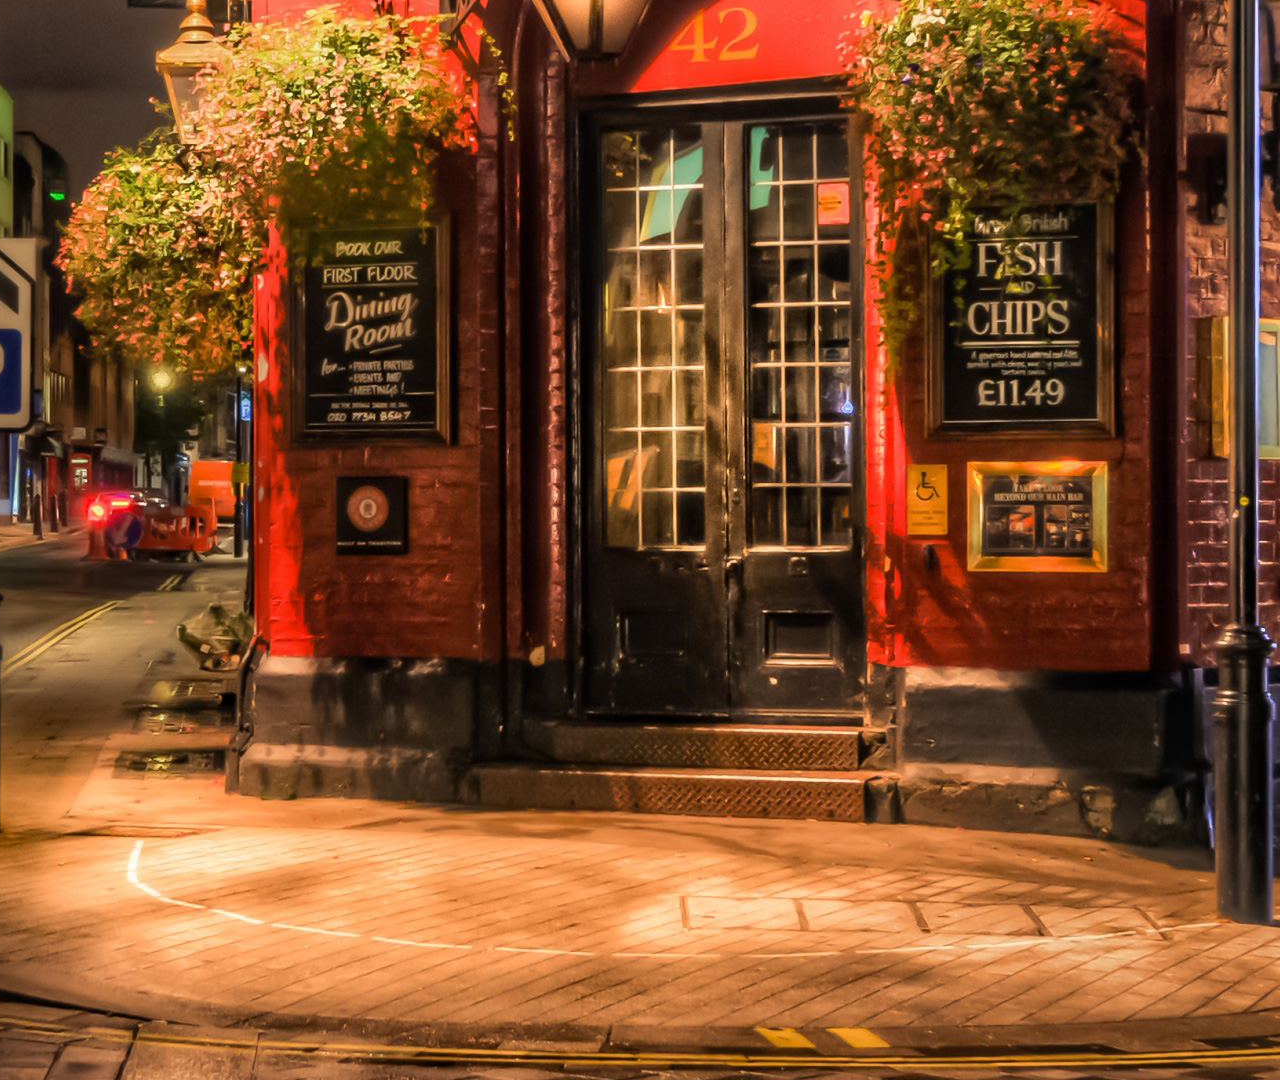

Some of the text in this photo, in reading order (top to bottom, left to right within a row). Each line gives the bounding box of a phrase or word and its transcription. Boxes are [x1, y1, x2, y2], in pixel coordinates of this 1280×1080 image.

[669, 6, 760, 63] 42
[336, 240, 404, 258] BOOK OUR
[977, 241, 1063, 277] FISH
[323, 265, 418, 284] FIRST FLOOR
[324, 290, 419, 331] Dining
[967, 299, 1070, 336] CHIPS
[344, 318, 416, 352] Room
[978, 378, 1065, 406] £11.49
